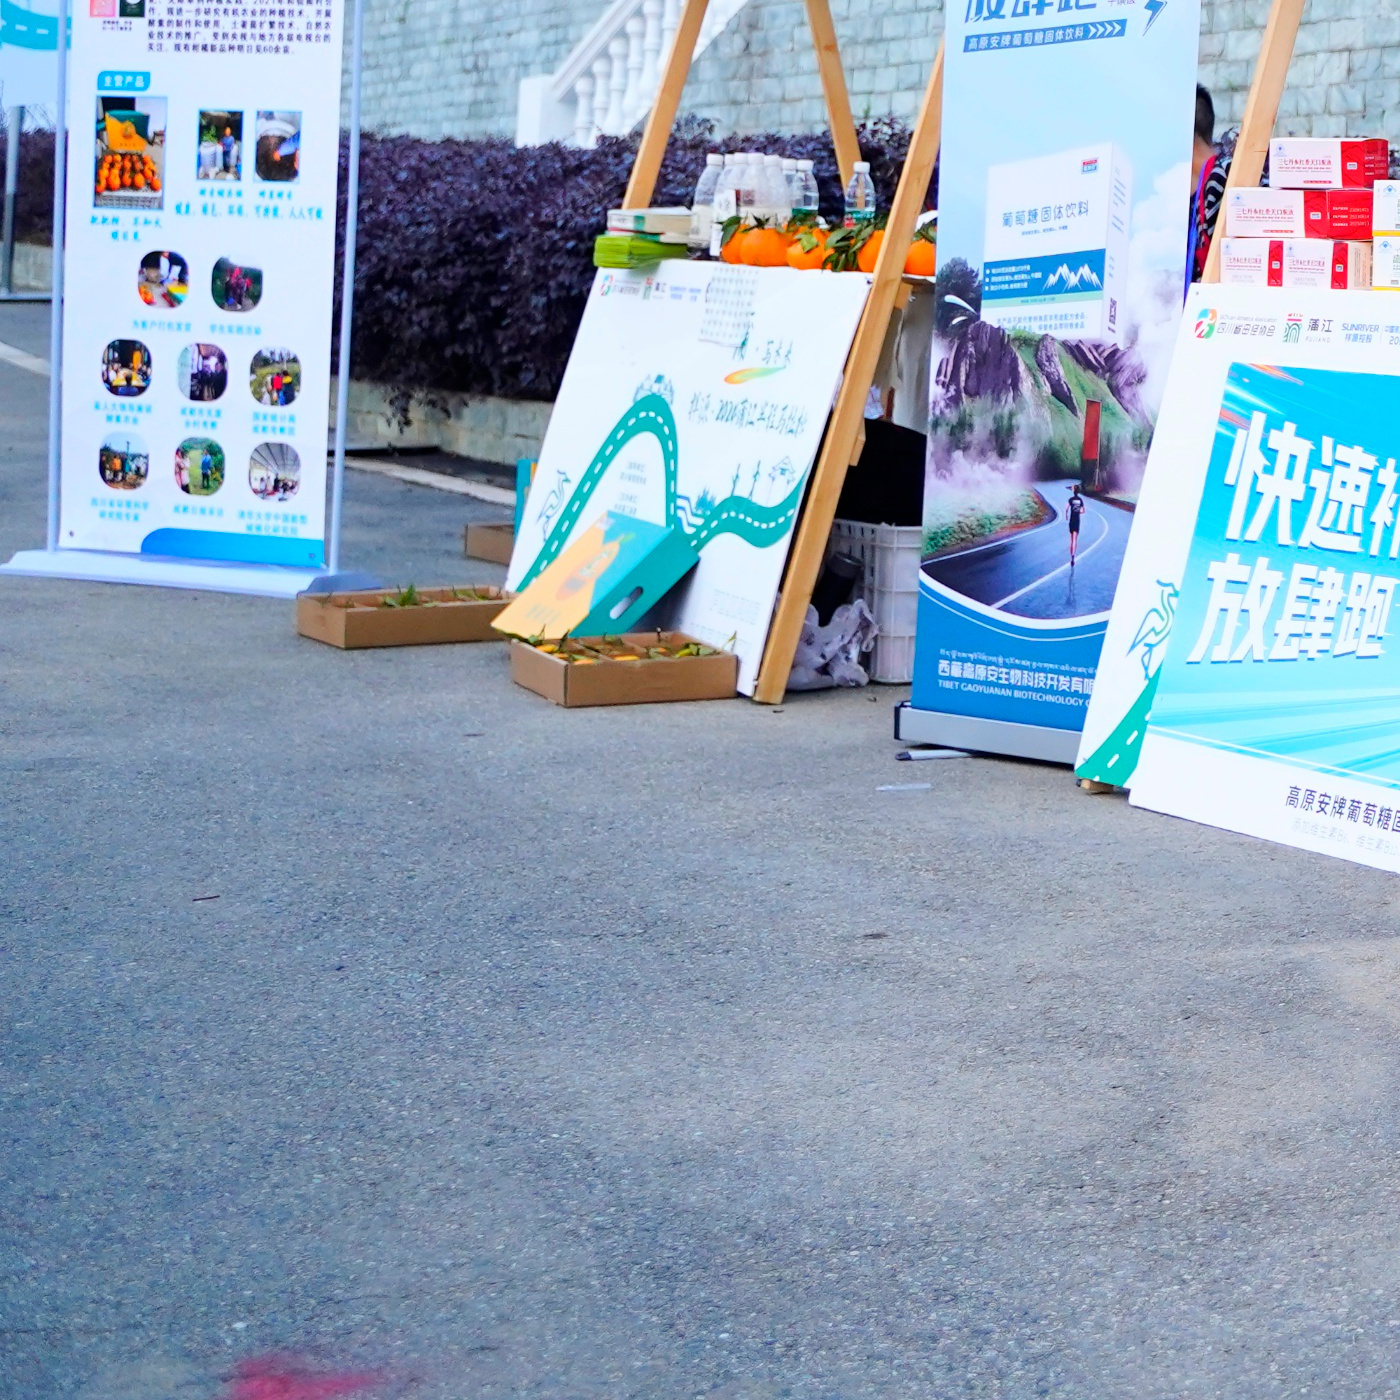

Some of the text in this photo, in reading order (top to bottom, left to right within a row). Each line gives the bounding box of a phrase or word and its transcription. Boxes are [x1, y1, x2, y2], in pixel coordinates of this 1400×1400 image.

[968, 27, 1084, 50] 高原安牌葡萄糖固体饮料
[1002, 200, 1089, 228] 葡萄糖固体饮料
[1307, 318, 1333, 332] 蒲江
[1341, 323, 1379, 332] SUNRIVER
